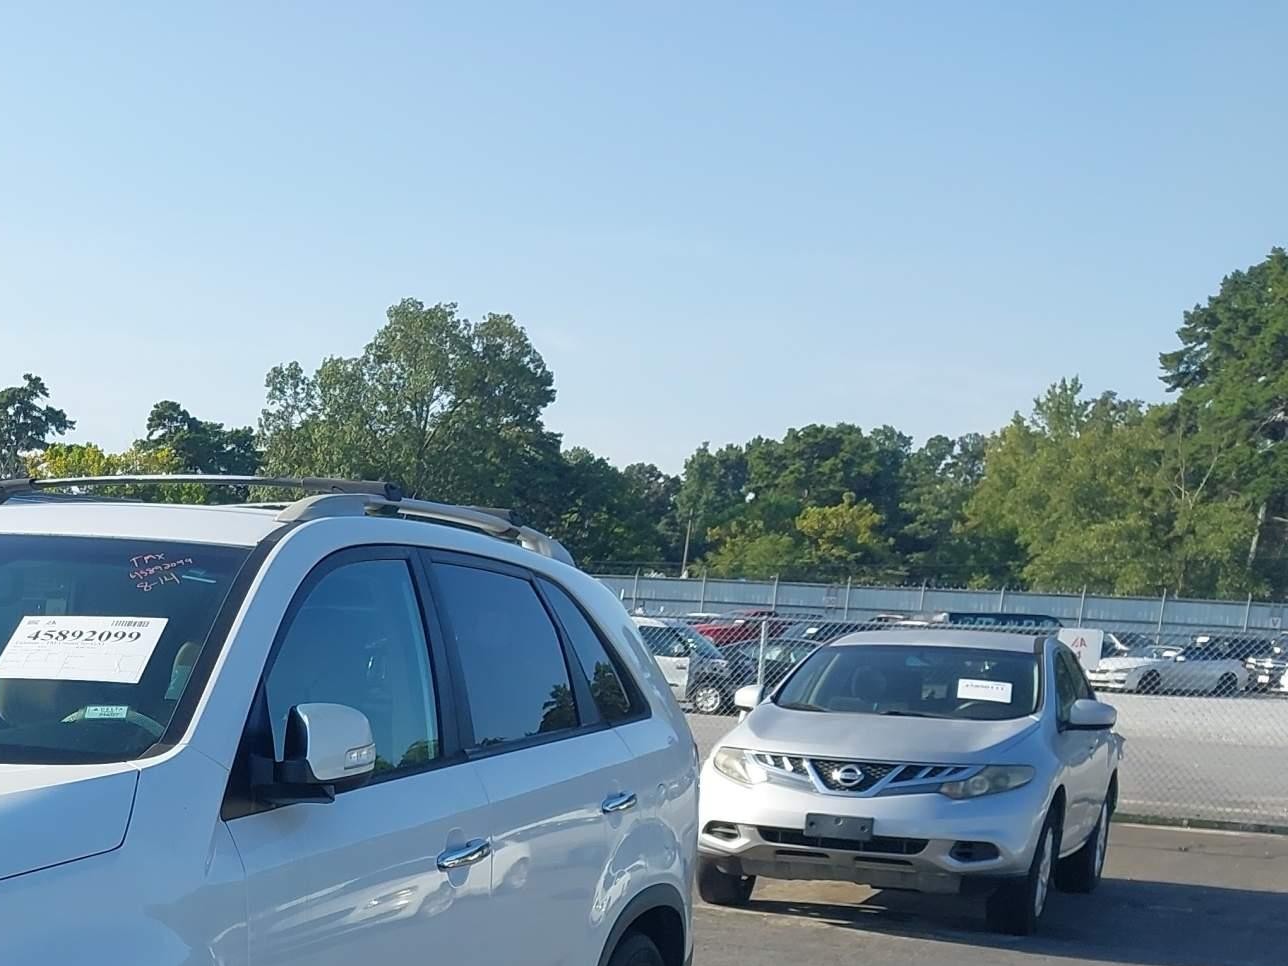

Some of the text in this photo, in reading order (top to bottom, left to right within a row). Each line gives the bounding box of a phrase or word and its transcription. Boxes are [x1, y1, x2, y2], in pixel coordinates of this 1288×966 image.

[129, 557, 193, 579] 45892099
[136, 572, 181, 592] 8-14
[26, 629, 142, 643] 45892099
